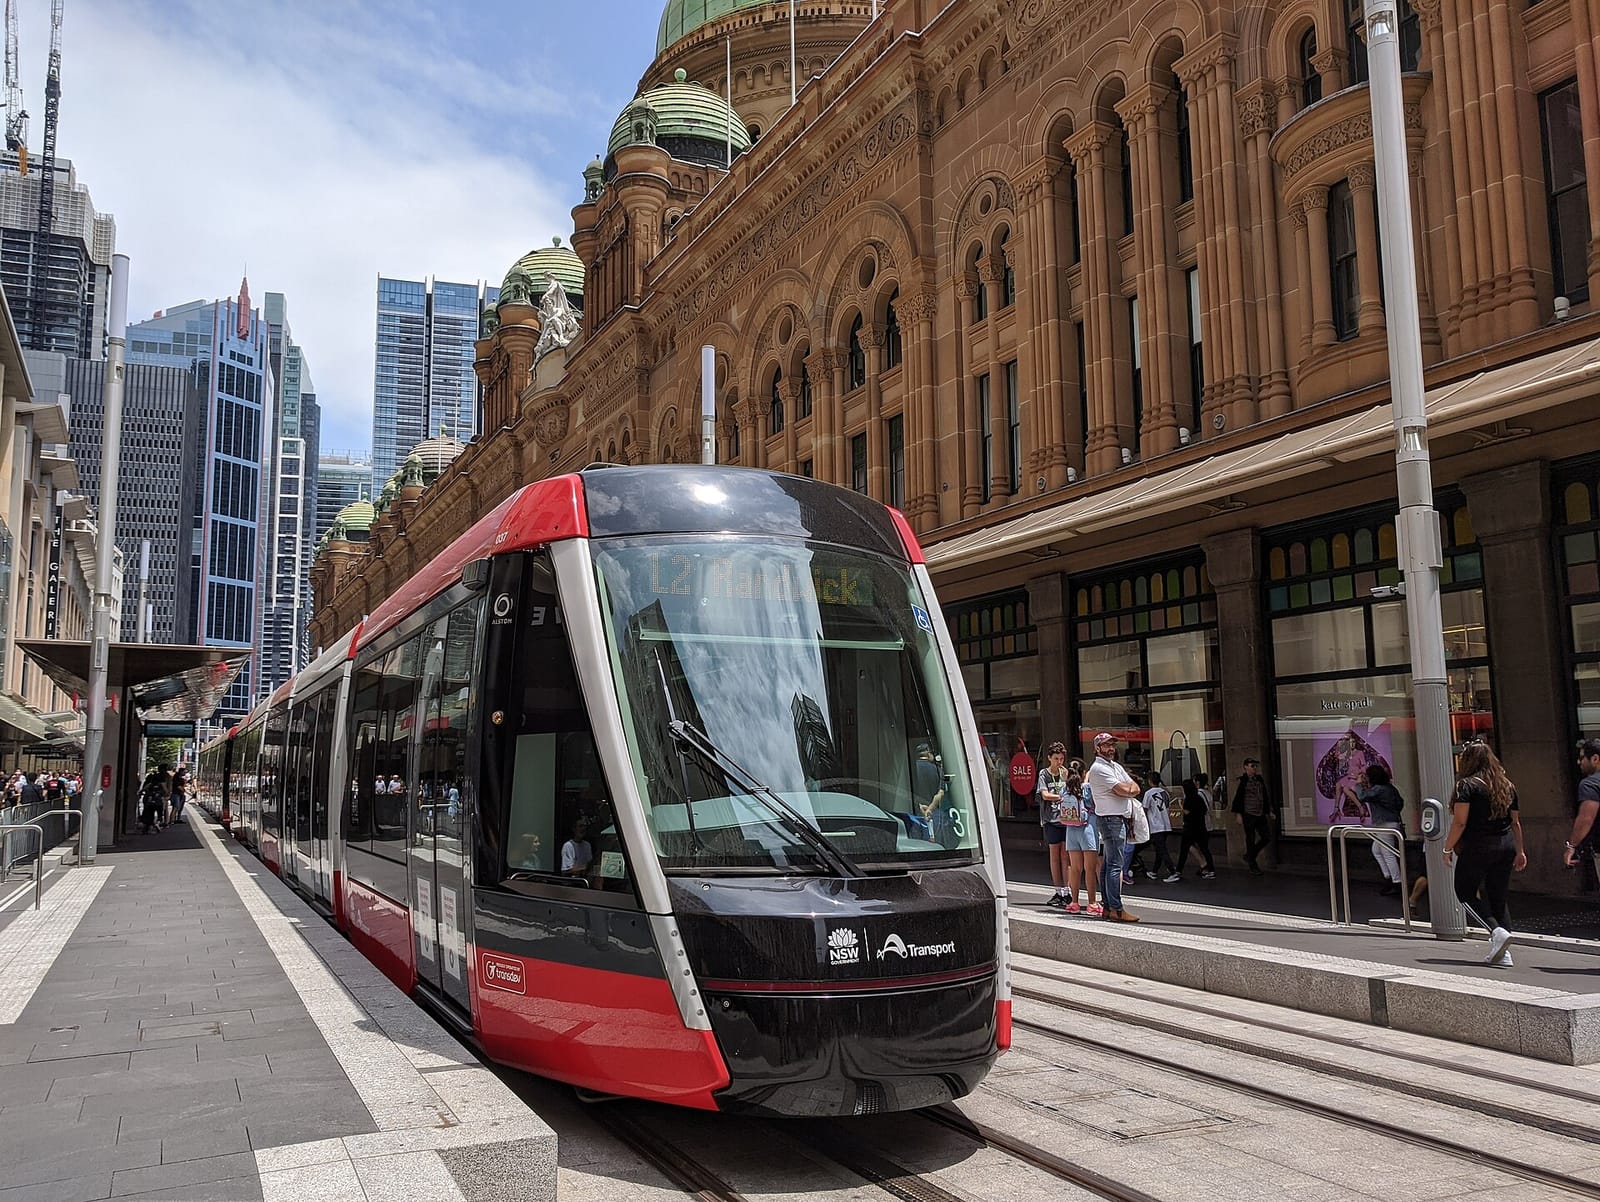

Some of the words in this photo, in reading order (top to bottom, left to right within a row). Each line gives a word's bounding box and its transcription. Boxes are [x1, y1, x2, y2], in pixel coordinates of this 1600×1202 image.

[52, 516, 61, 548] THE
[651, 552, 692, 596] L2
[1012, 765, 1032, 775] SALE
[829, 947, 859, 961] NSW
[907, 941, 956, 957] Transport
